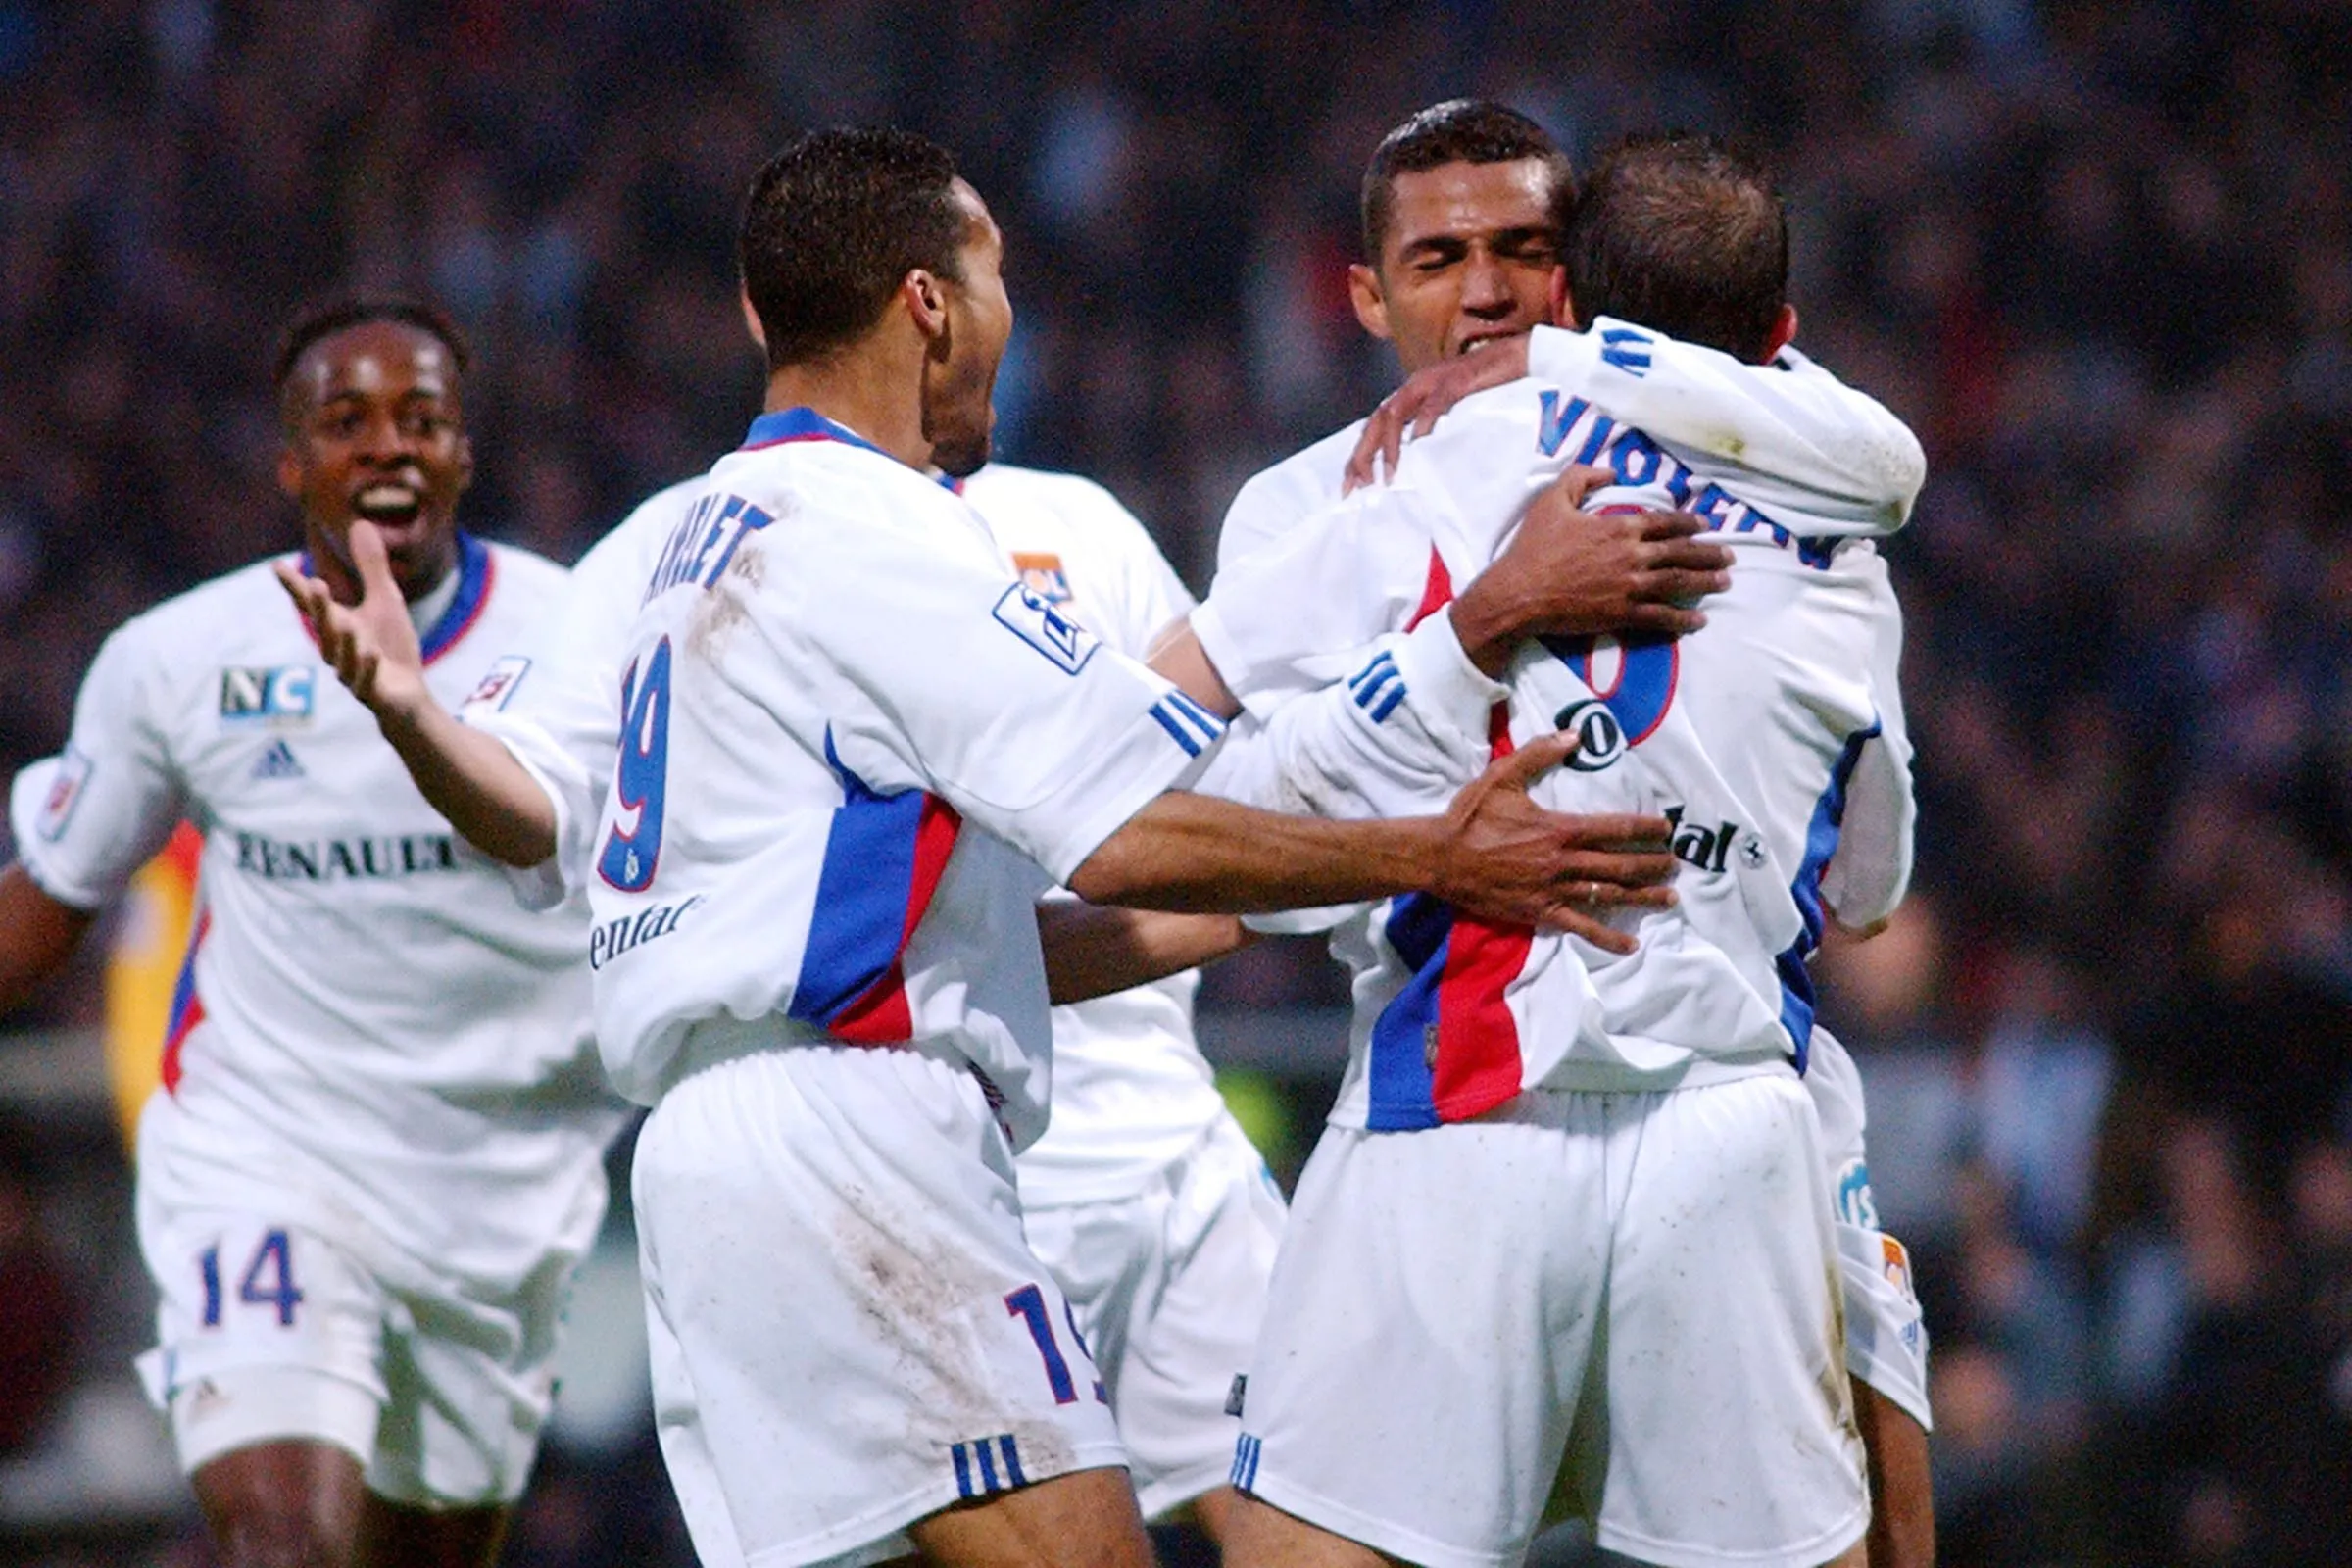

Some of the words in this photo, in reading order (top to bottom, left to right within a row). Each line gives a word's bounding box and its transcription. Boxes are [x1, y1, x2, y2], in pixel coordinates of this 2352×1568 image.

[597, 633, 672, 893] 9
[238, 832, 458, 880] RENAULT
[197, 1228, 305, 1328] 14
[1004, 1282, 1109, 1405] 1
